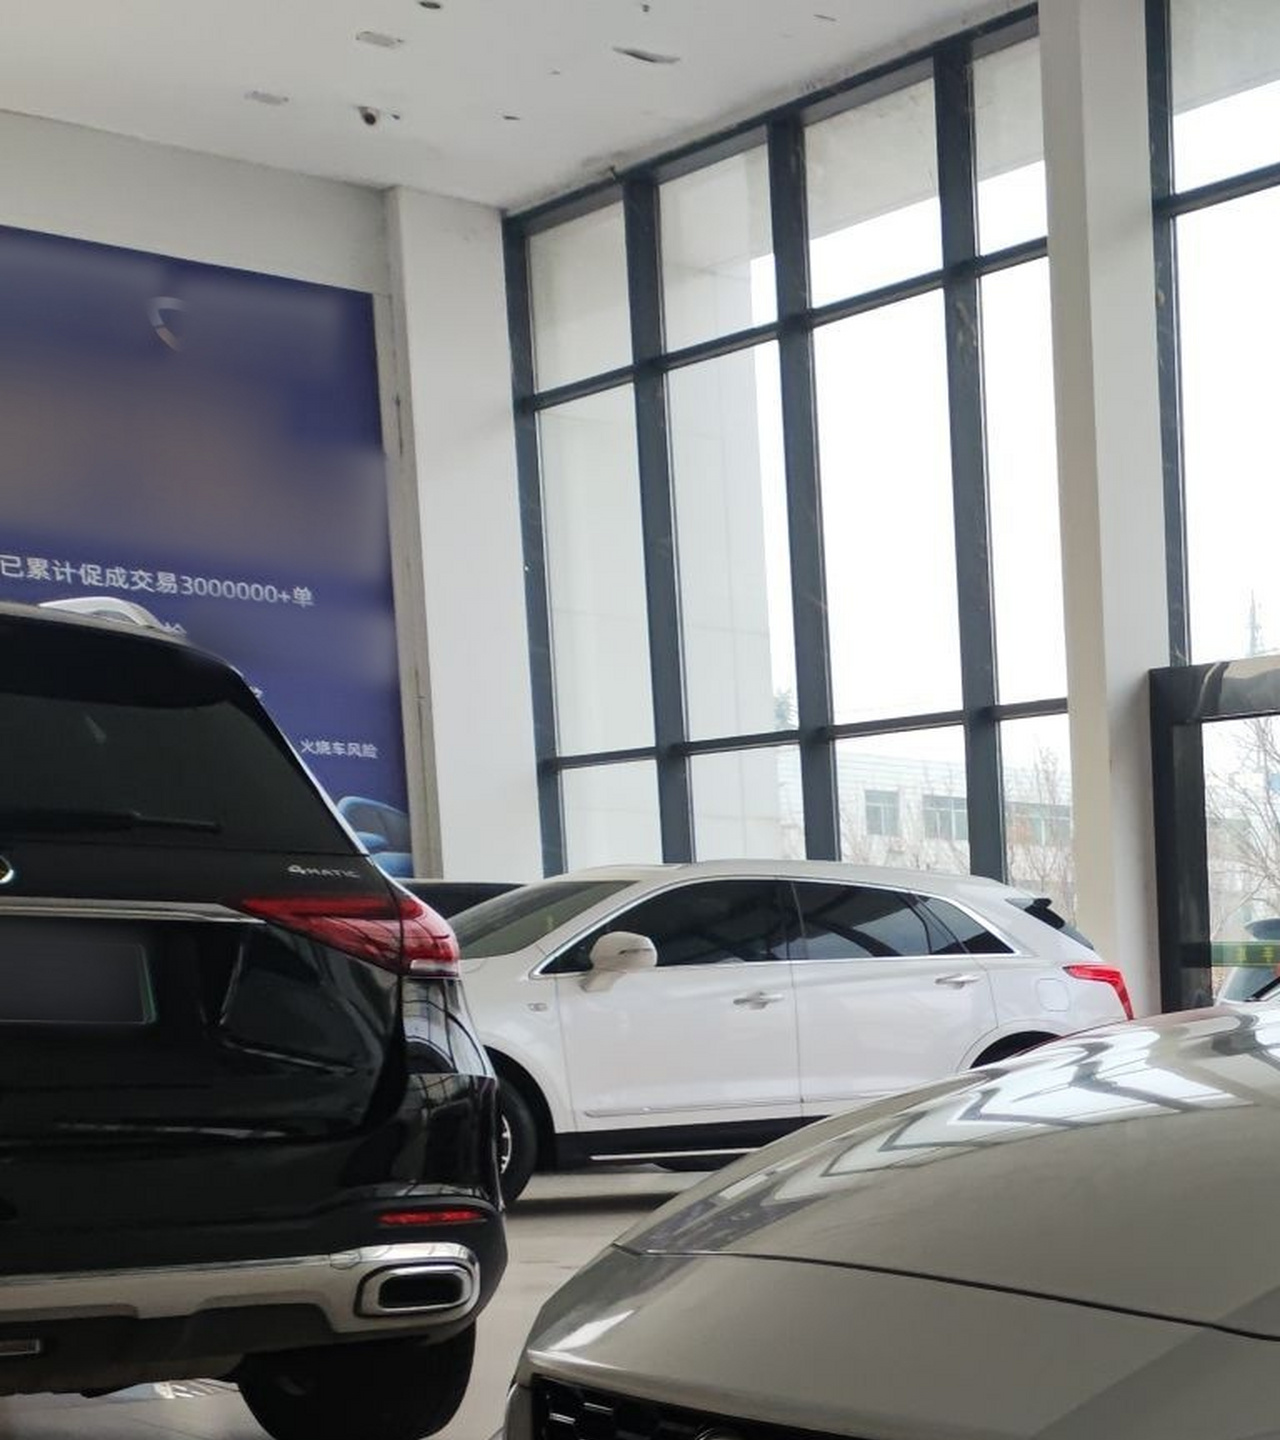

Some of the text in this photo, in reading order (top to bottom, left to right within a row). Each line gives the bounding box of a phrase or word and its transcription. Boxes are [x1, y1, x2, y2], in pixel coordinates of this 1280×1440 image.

[0, 554, 314, 607] 已累计促成交易3000000+单
[287, 864, 360, 879] 4MATIC
